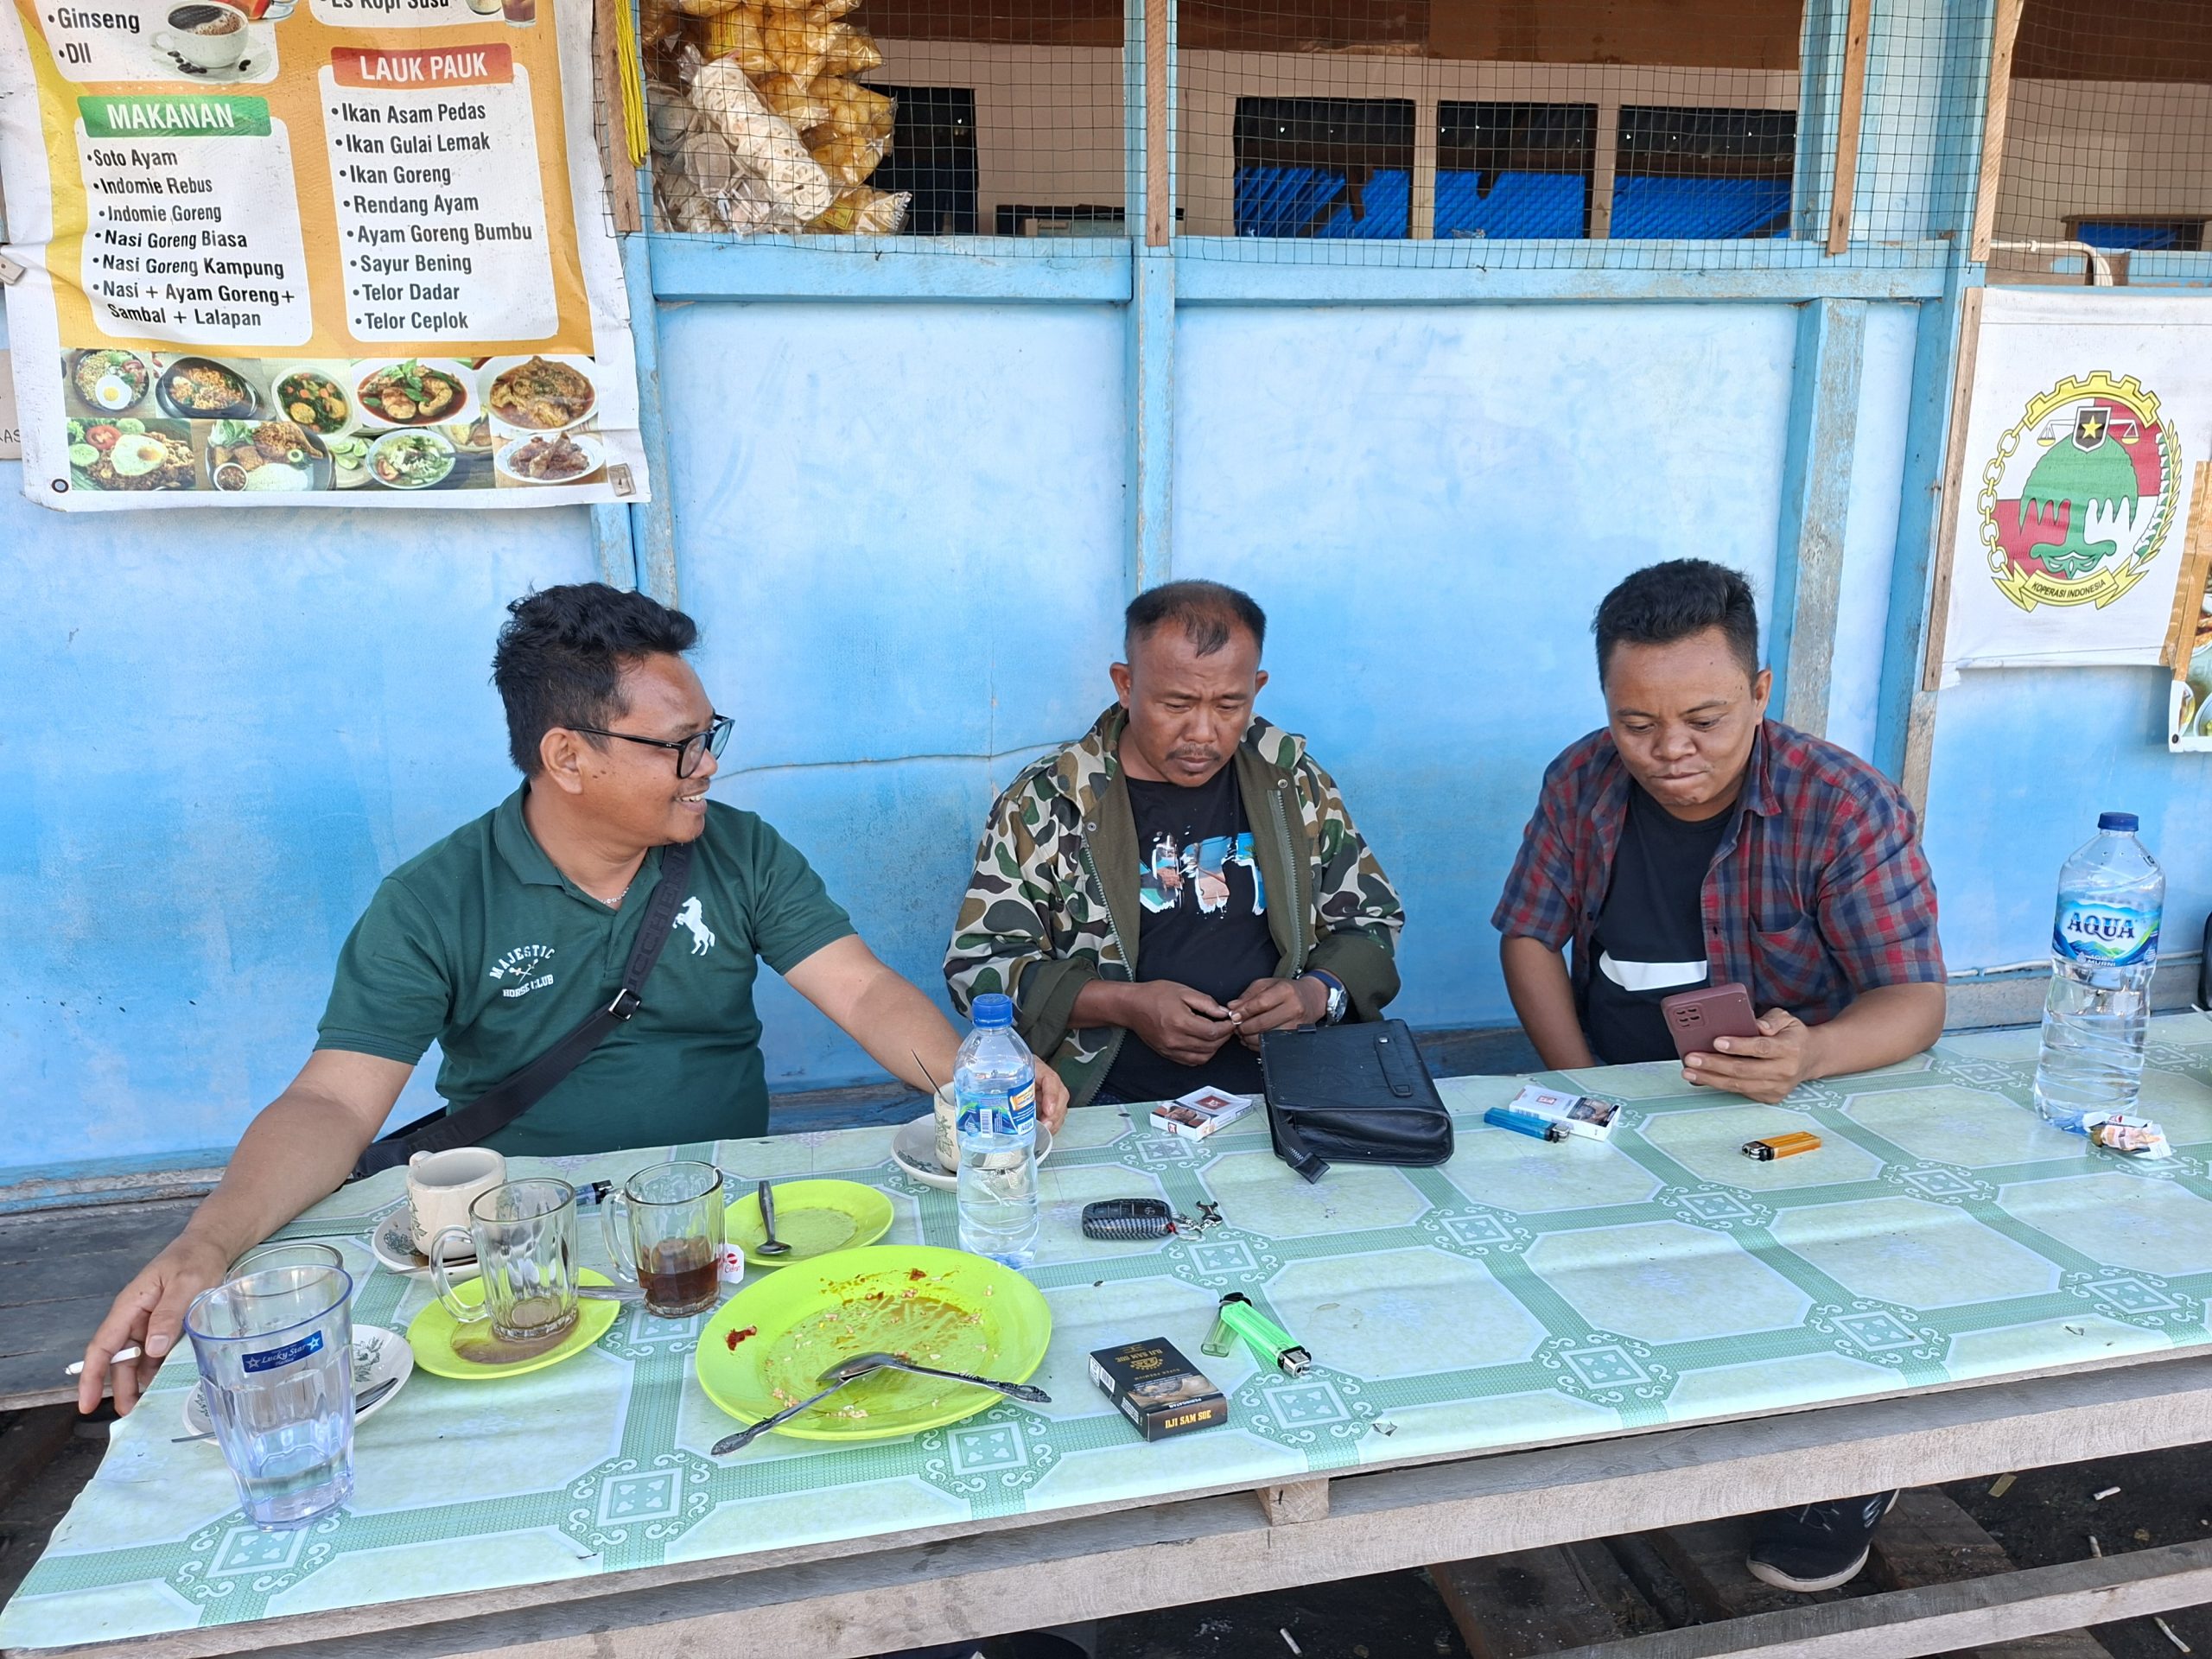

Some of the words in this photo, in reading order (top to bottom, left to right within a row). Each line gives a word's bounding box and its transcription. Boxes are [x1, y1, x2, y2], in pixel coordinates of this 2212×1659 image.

[58, 8, 140, 34] Ginseng
[66, 42, 92, 64] Dll
[360, 55, 423, 81] LAUK
[430, 53, 487, 79] PAUK
[106, 103, 234, 129] MAKANAN
[342, 103, 381, 123] Ikan
[388, 104, 433, 124] Asam
[438, 103, 486, 121] Pedas
[346, 134, 384, 154] Ikan
[391, 135, 432, 154] Gulai
[437, 131, 491, 152] Lemak
[93, 149, 126, 168] Soto
[131, 149, 178, 169] Ayam
[99, 178, 162, 195] Indomie
[166, 177, 213, 194] Rebus
[350, 165, 387, 183] Ikan
[393, 165, 451, 185] Goreng
[108, 207, 166, 222] Indomie
[172, 206, 221, 223] Goreng
[353, 195, 429, 216] Rendang
[434, 194, 479, 214] Ayam
[105, 230, 142, 247] Nasi
[148, 232, 197, 250] Goreng
[202, 230, 247, 248] Biasa
[358, 226, 405, 246] Ayam
[410, 226, 468, 244] Goreng
[474, 222, 532, 241] Bumbu
[103, 254, 139, 273] Nasi
[146, 258, 198, 277] Goreng
[204, 258, 284, 280] Kampung
[361, 255, 409, 276] Sayur
[416, 254, 472, 275] Bening
[103, 280, 139, 298] Nasi
[166, 283, 213, 303] Ayam
[362, 283, 403, 301] Telor
[410, 283, 460, 301] Dadar
[107, 303, 166, 323] Sambal
[194, 308, 261, 328] Lalapan
[365, 312, 405, 329] Telor
[410, 312, 469, 332] Ceplok
[2031, 582, 2066, 598] KOPERASI
[2067, 579, 2106, 598] INDONESIA
[2068, 912, 2134, 942] AQUA
[489, 944, 555, 980] MAJESTIC
[502, 982, 531, 997] HORSE
[531, 974, 554, 990] CLUB
[262, 1350, 288, 1363] Lucky
[289, 1344, 305, 1357] Star
[1179, 1413, 1197, 1426] SAM
